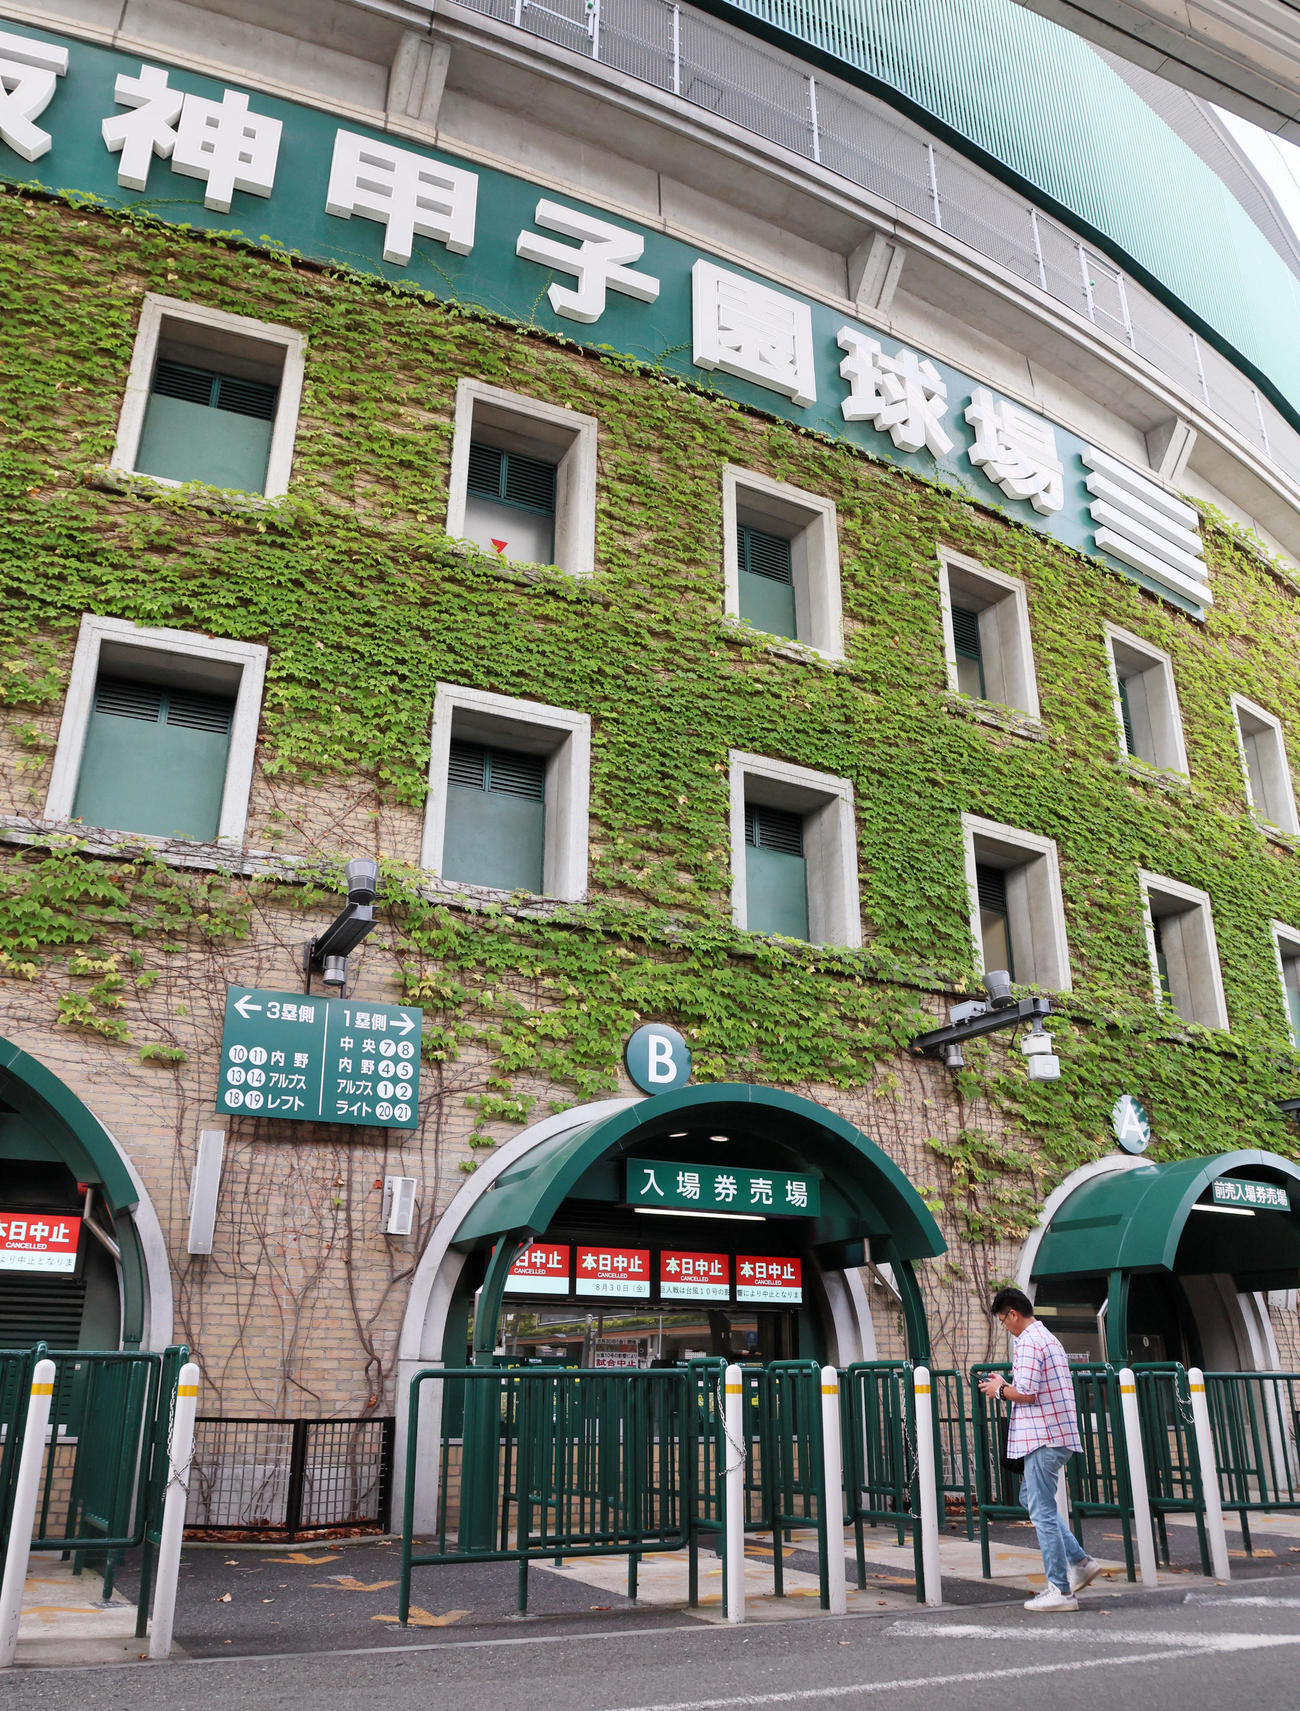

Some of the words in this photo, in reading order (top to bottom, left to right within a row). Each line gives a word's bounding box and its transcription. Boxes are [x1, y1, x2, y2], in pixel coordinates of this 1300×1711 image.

[266, 1001, 315, 1024] 3塁側
[343, 1009, 388, 1032] 1塁側
[648, 1034, 678, 1084] B
[268, 1072, 307, 1090] アルプス
[336, 1078, 373, 1096] アルプス
[267, 1093, 305, 1111] レフト
[335, 1100, 373, 1117] ライト
[1120, 1100, 1147, 1143] A
[639, 1168, 808, 1208] 入場券売場
[1213, 1180, 1288, 1207] 前売入場券売場
[5, 1241, 48, 1250] CANCELLED
[514, 1250, 563, 1269] 日中止
[581, 1253, 644, 1273] 本日中止
[665, 1256, 723, 1276] 本日中止
[513, 1267, 546, 1275] CANCELLED
[597, 1271, 628, 1279] CANCELLED
[680, 1275, 709, 1283] CANCELLED
[740, 1261, 796, 1280] 本日中止
[754, 1278, 782, 1286] CANCELLED
[596, 1358, 636, 1367] 試合中止
